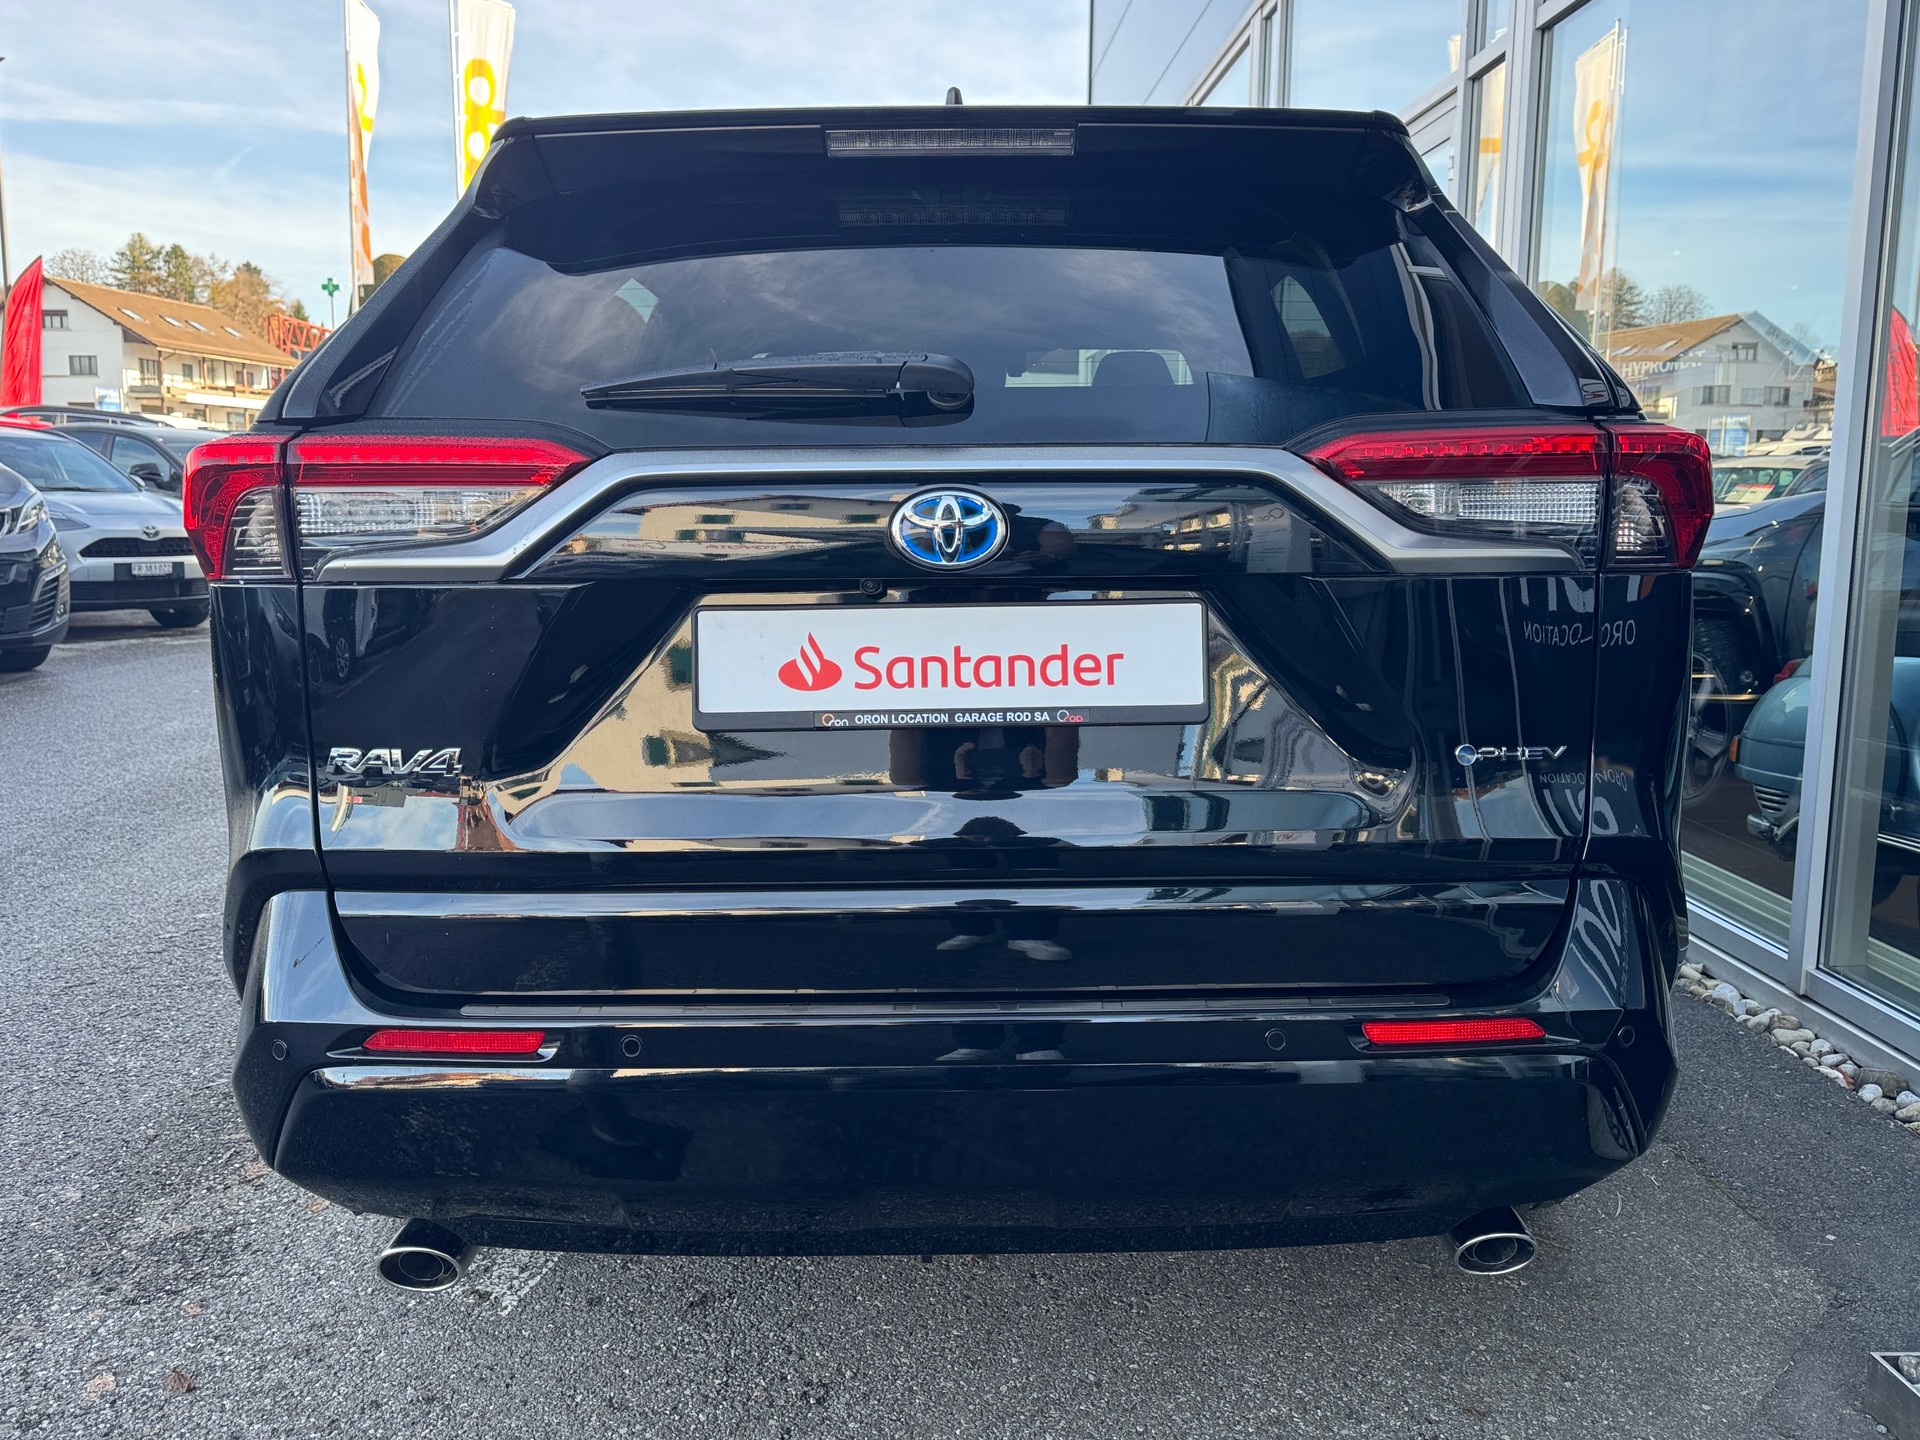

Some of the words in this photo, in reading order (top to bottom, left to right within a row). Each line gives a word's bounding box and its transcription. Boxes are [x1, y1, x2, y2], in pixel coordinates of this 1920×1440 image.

[854, 644, 1124, 690] Santander
[855, 714, 888, 724] ORON
[891, 713, 949, 723] LOCATION
[954, 712, 1004, 723] GARAGE
[1006, 712, 1032, 721] ROD
[1034, 711, 1050, 721] SA
[325, 747, 463, 777] RAV4
[1477, 745, 1567, 761] PHEV
